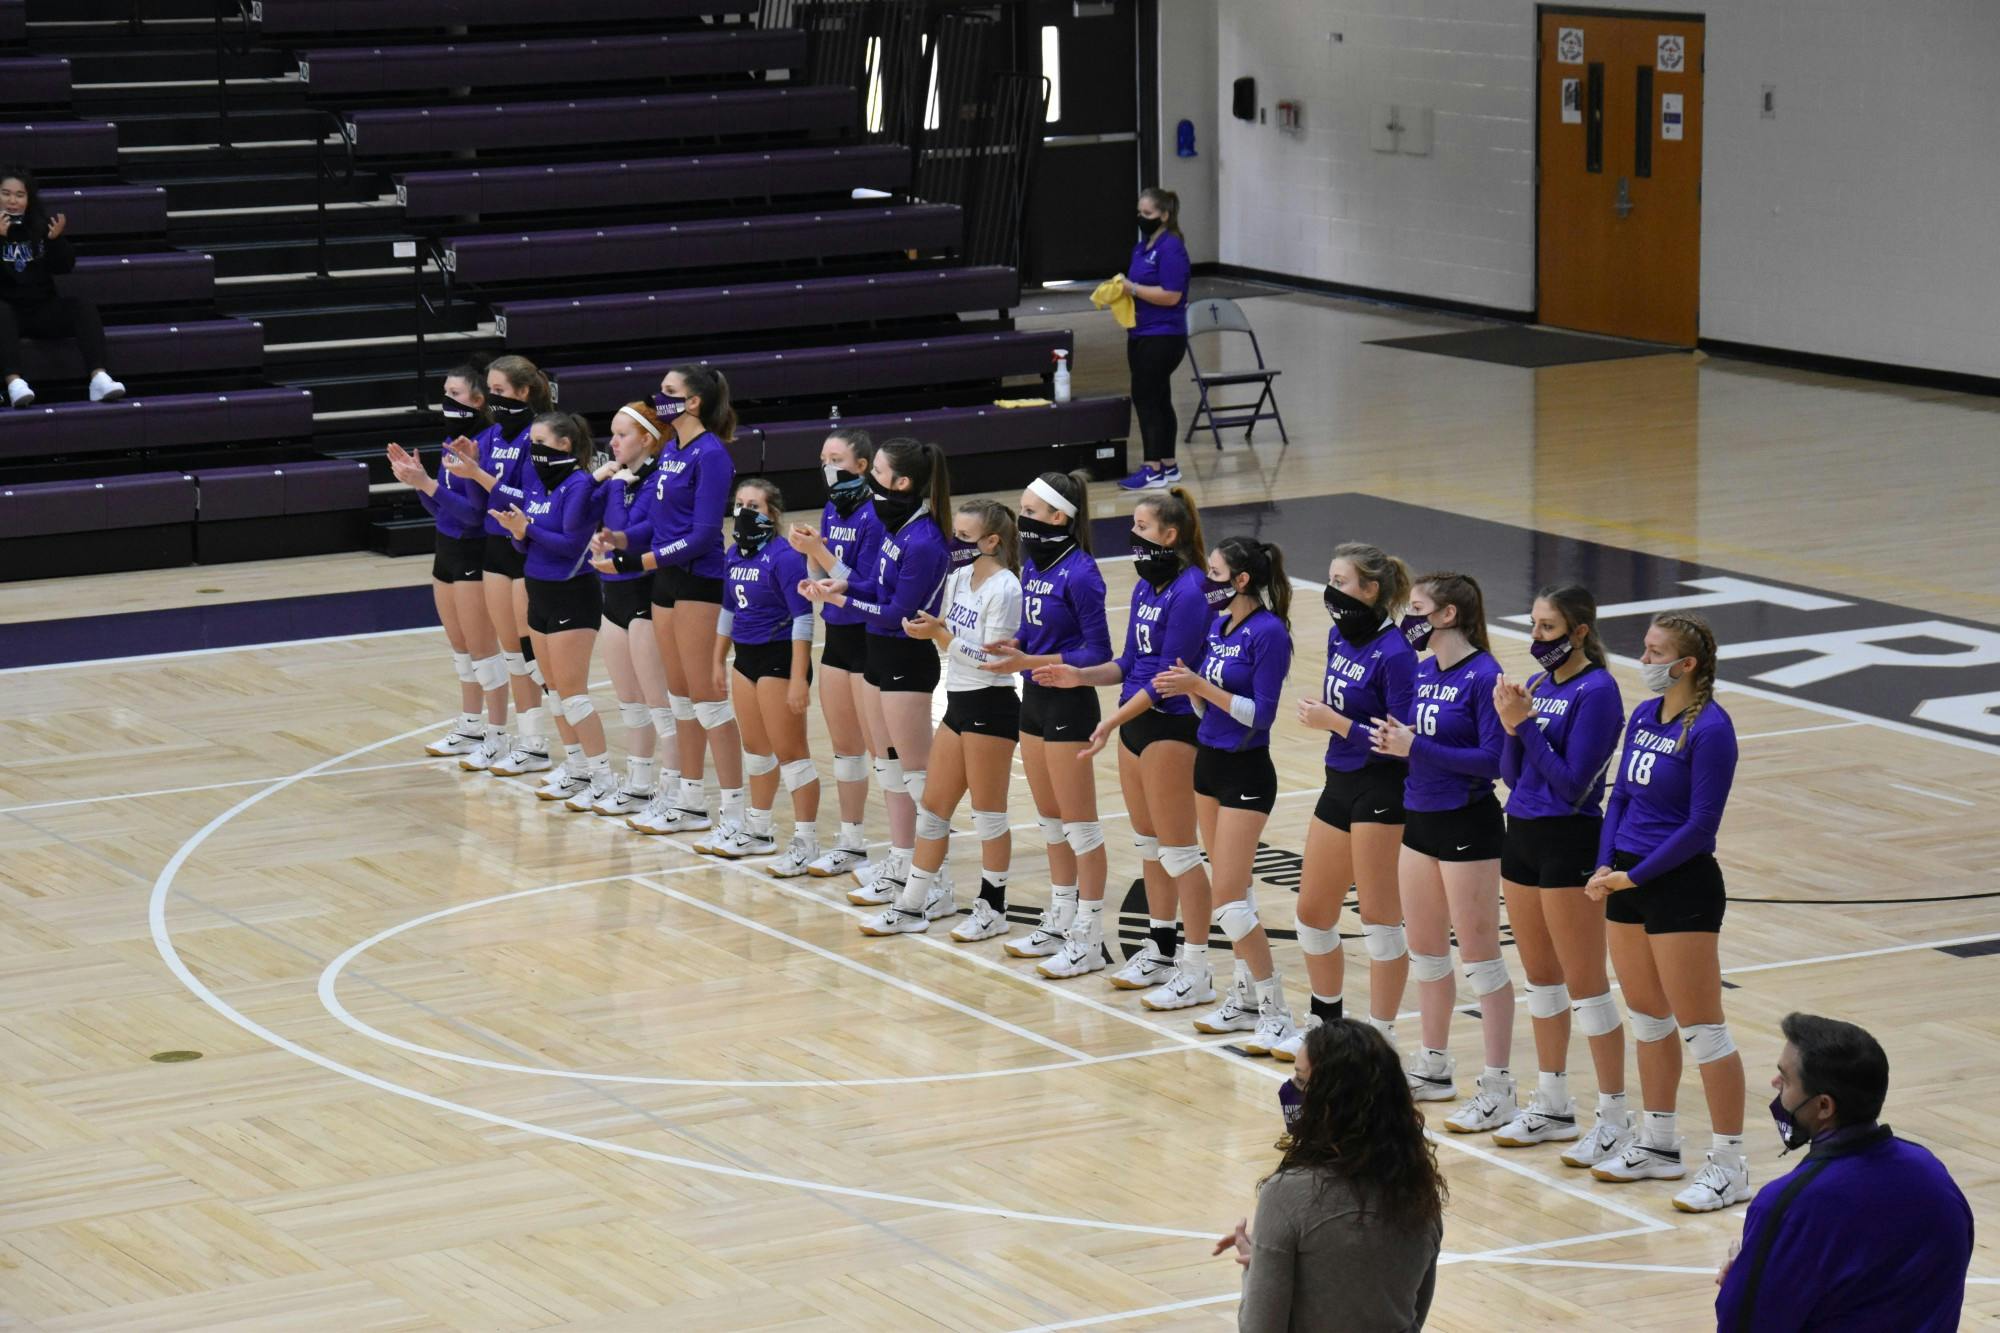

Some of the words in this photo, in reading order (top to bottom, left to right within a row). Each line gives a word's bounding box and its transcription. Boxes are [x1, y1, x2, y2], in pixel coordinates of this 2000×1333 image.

[659, 459, 687, 474] AYLOR
[656, 474, 668, 501] 5
[829, 525, 857, 542] TAYLOR
[659, 538, 688, 557] TROJANS
[881, 536, 901, 562] AYLOR
[730, 567, 760, 582] TAYLOR
[1024, 579, 1054, 595] AYLOR
[734, 584, 749, 609] 6
[1025, 596, 1043, 627] 12
[1135, 622, 1153, 654] 13
[1205, 656, 1224, 689] 14
[1331, 653, 1366, 681] TAYLOR
[1326, 674, 1348, 712] 15
[1417, 683, 1459, 703] TAYLOR
[1416, 702, 1440, 737] 16
[1532, 697, 1569, 716] TAYLOR
[1633, 729, 1676, 755] TAYLOR
[1627, 749, 1657, 786] 18
